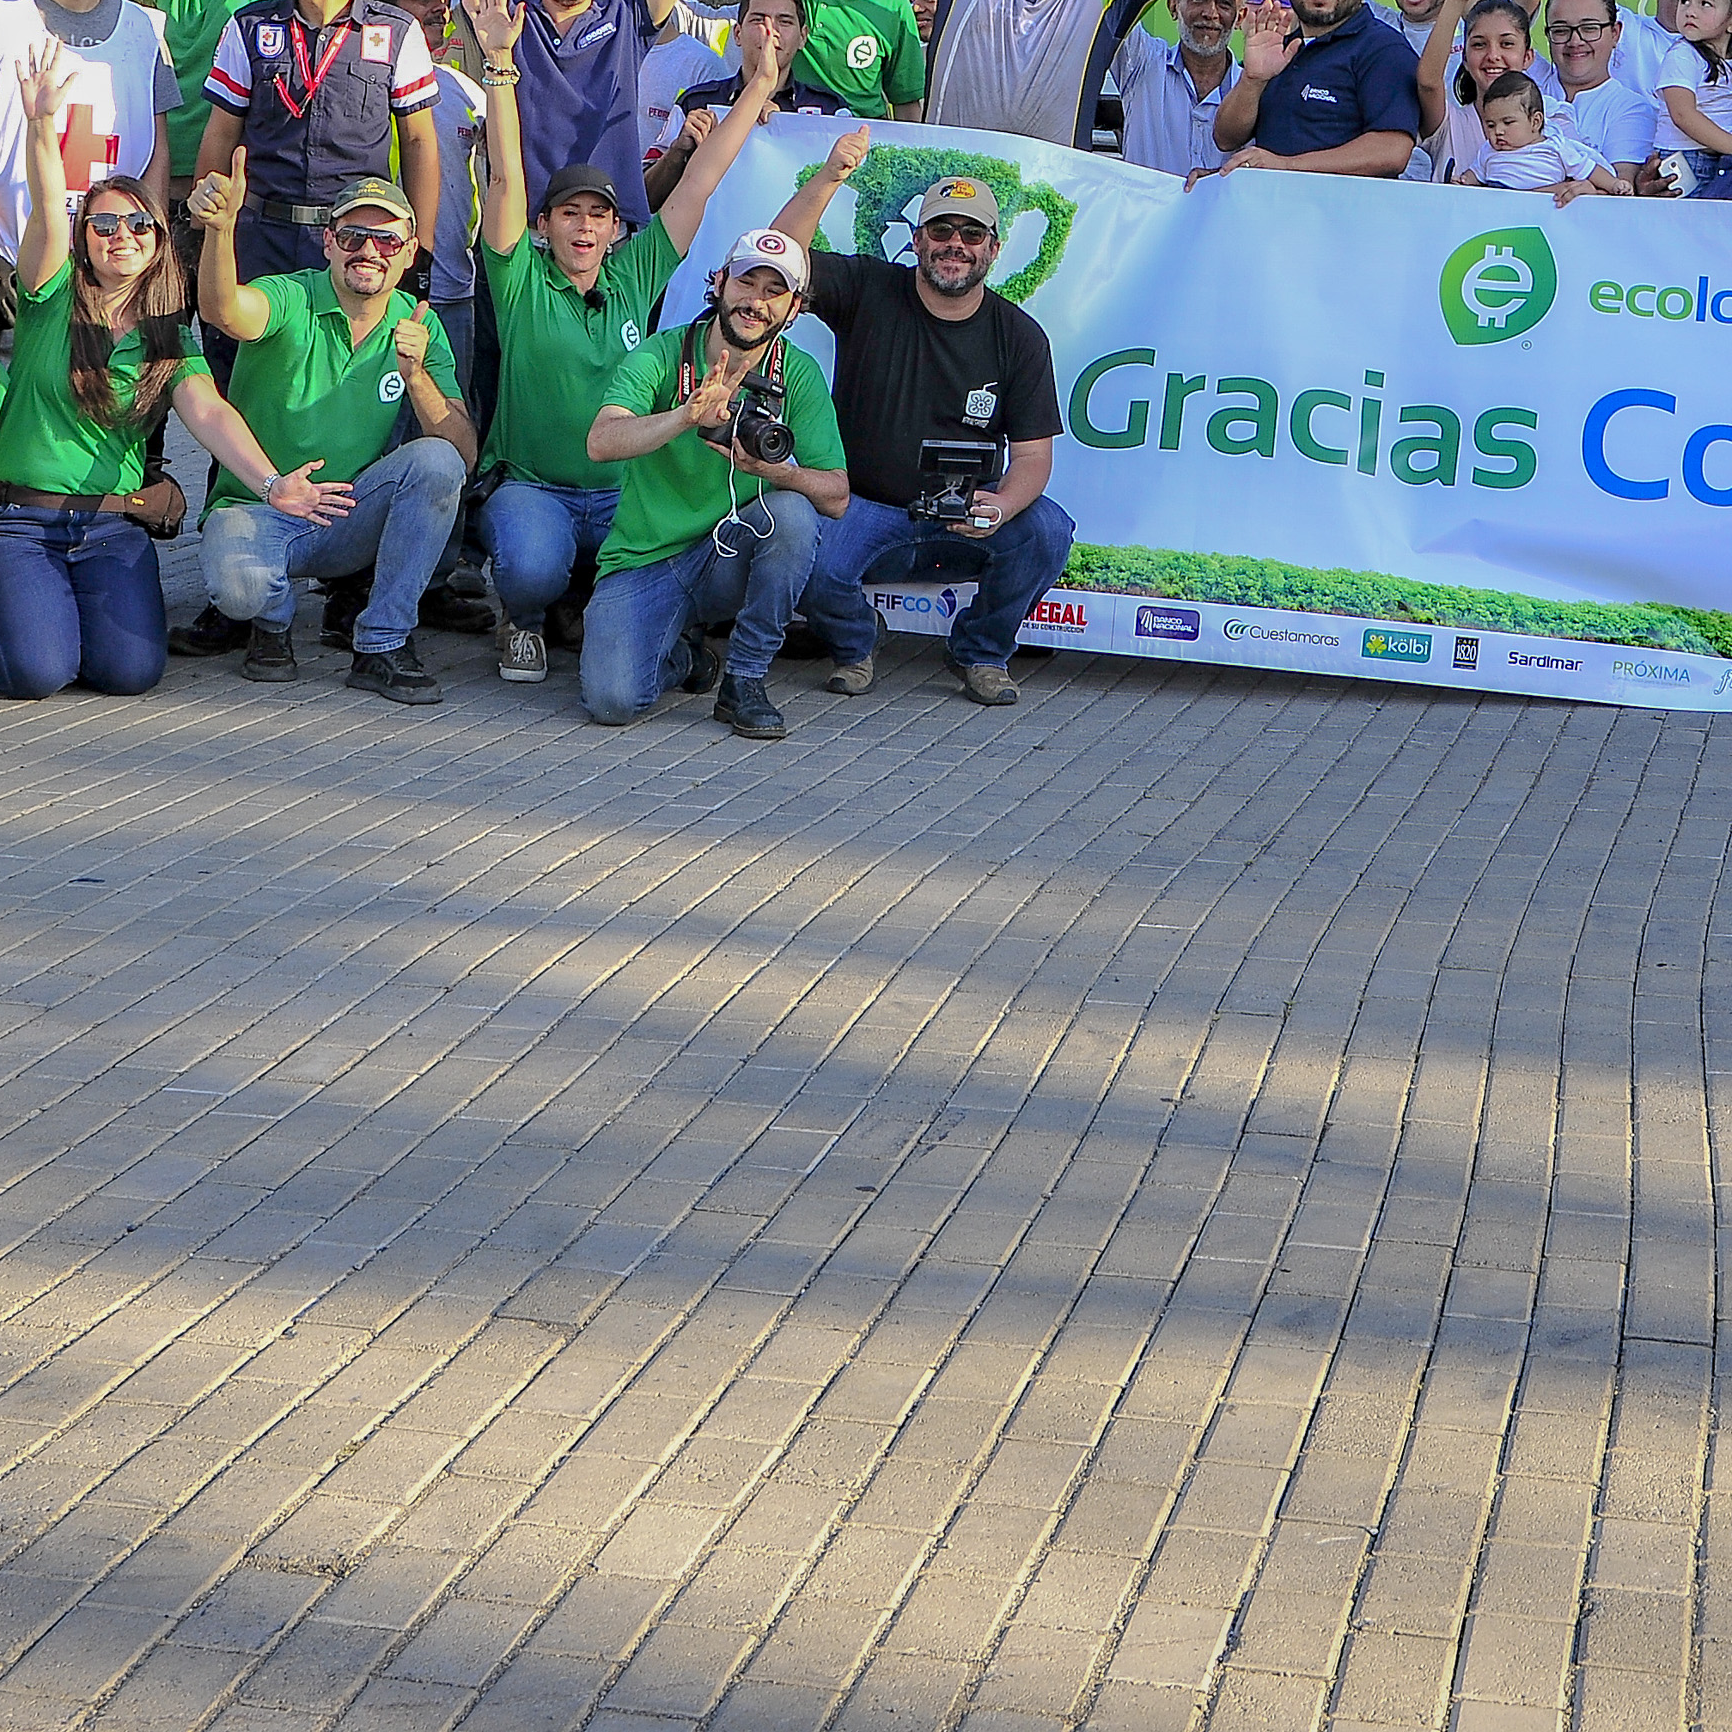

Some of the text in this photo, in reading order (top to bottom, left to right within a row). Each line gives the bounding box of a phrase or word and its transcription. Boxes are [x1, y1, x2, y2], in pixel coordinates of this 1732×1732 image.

[1068, 346, 1539, 490] Gracias
[874, 592, 932, 612] FIFCO
[1153, 615, 1182, 626] BANCO
[1153, 621, 1194, 634] NACIONAL
[1249, 625, 1340, 647] Cuestamoras
[1387, 635, 1429, 656] kölbi
[1456, 644, 1477, 662] 1820
[1508, 651, 1583, 671] Sardimar
[1612, 660, 1690, 683] PRÓXIMA
